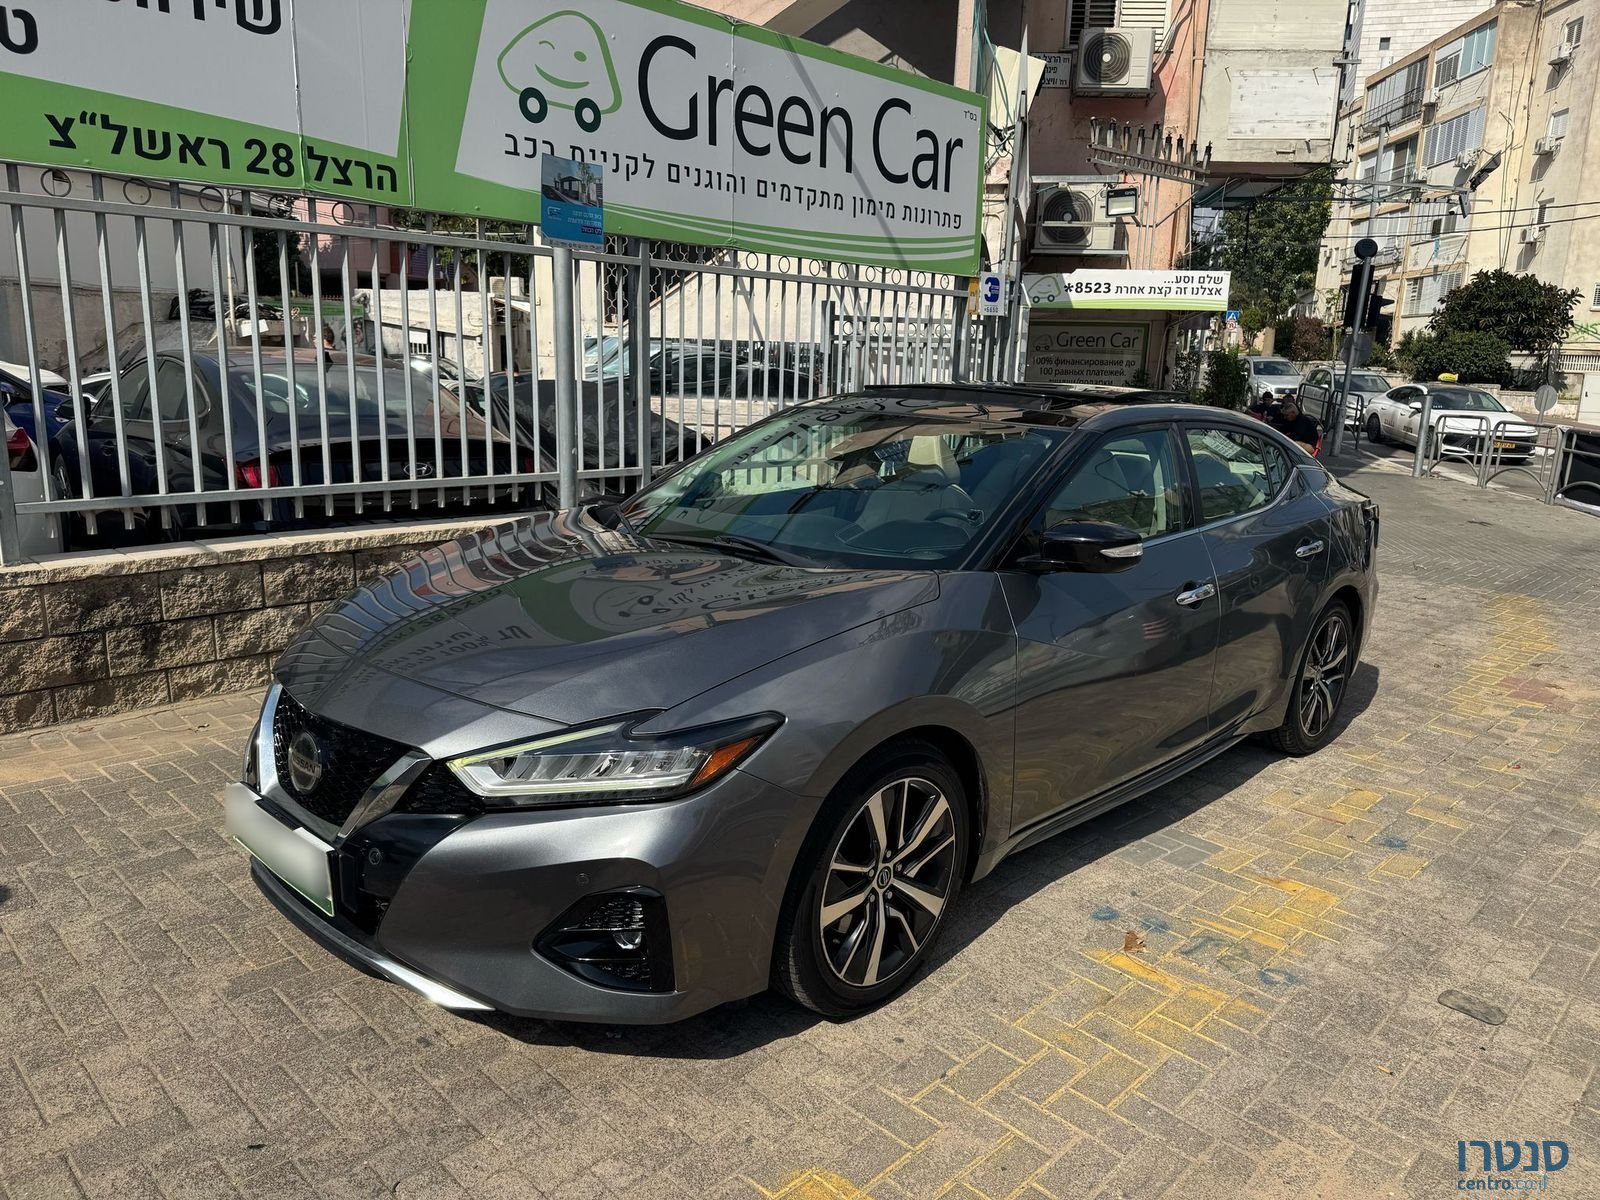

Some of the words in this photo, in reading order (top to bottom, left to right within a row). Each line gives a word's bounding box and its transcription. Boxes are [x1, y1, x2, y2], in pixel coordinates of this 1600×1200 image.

[637, 35, 854, 174] Green
[872, 97, 963, 193] Car
[244, 138, 294, 178] 28
[504, 132, 556, 160] רכב
[307, 145, 398, 192] הרצל
[569, 142, 656, 184] לקניית
[666, 163, 747, 195] והוגנים
[756, 178, 844, 214] מתקדמים
[852, 194, 896, 218] מימון
[902, 204, 963, 230] פתרונות
[1115, 285, 1145, 295] אחרת
[1176, 286, 1188, 296] זה
[1191, 285, 1223, 296] אצלנו
[1198, 274, 1224, 285] שלם
[1148, 286, 1172, 298] קצת
[1056, 331, 1106, 349] Green
[1110, 331, 1140, 349] Car
[1032, 356, 1053, 366] 100%
[1054, 357, 1124, 367] финансирование
[1125, 359, 1136, 367] до
[1039, 367, 1053, 376] 100
[1054, 368, 1085, 377] равных
